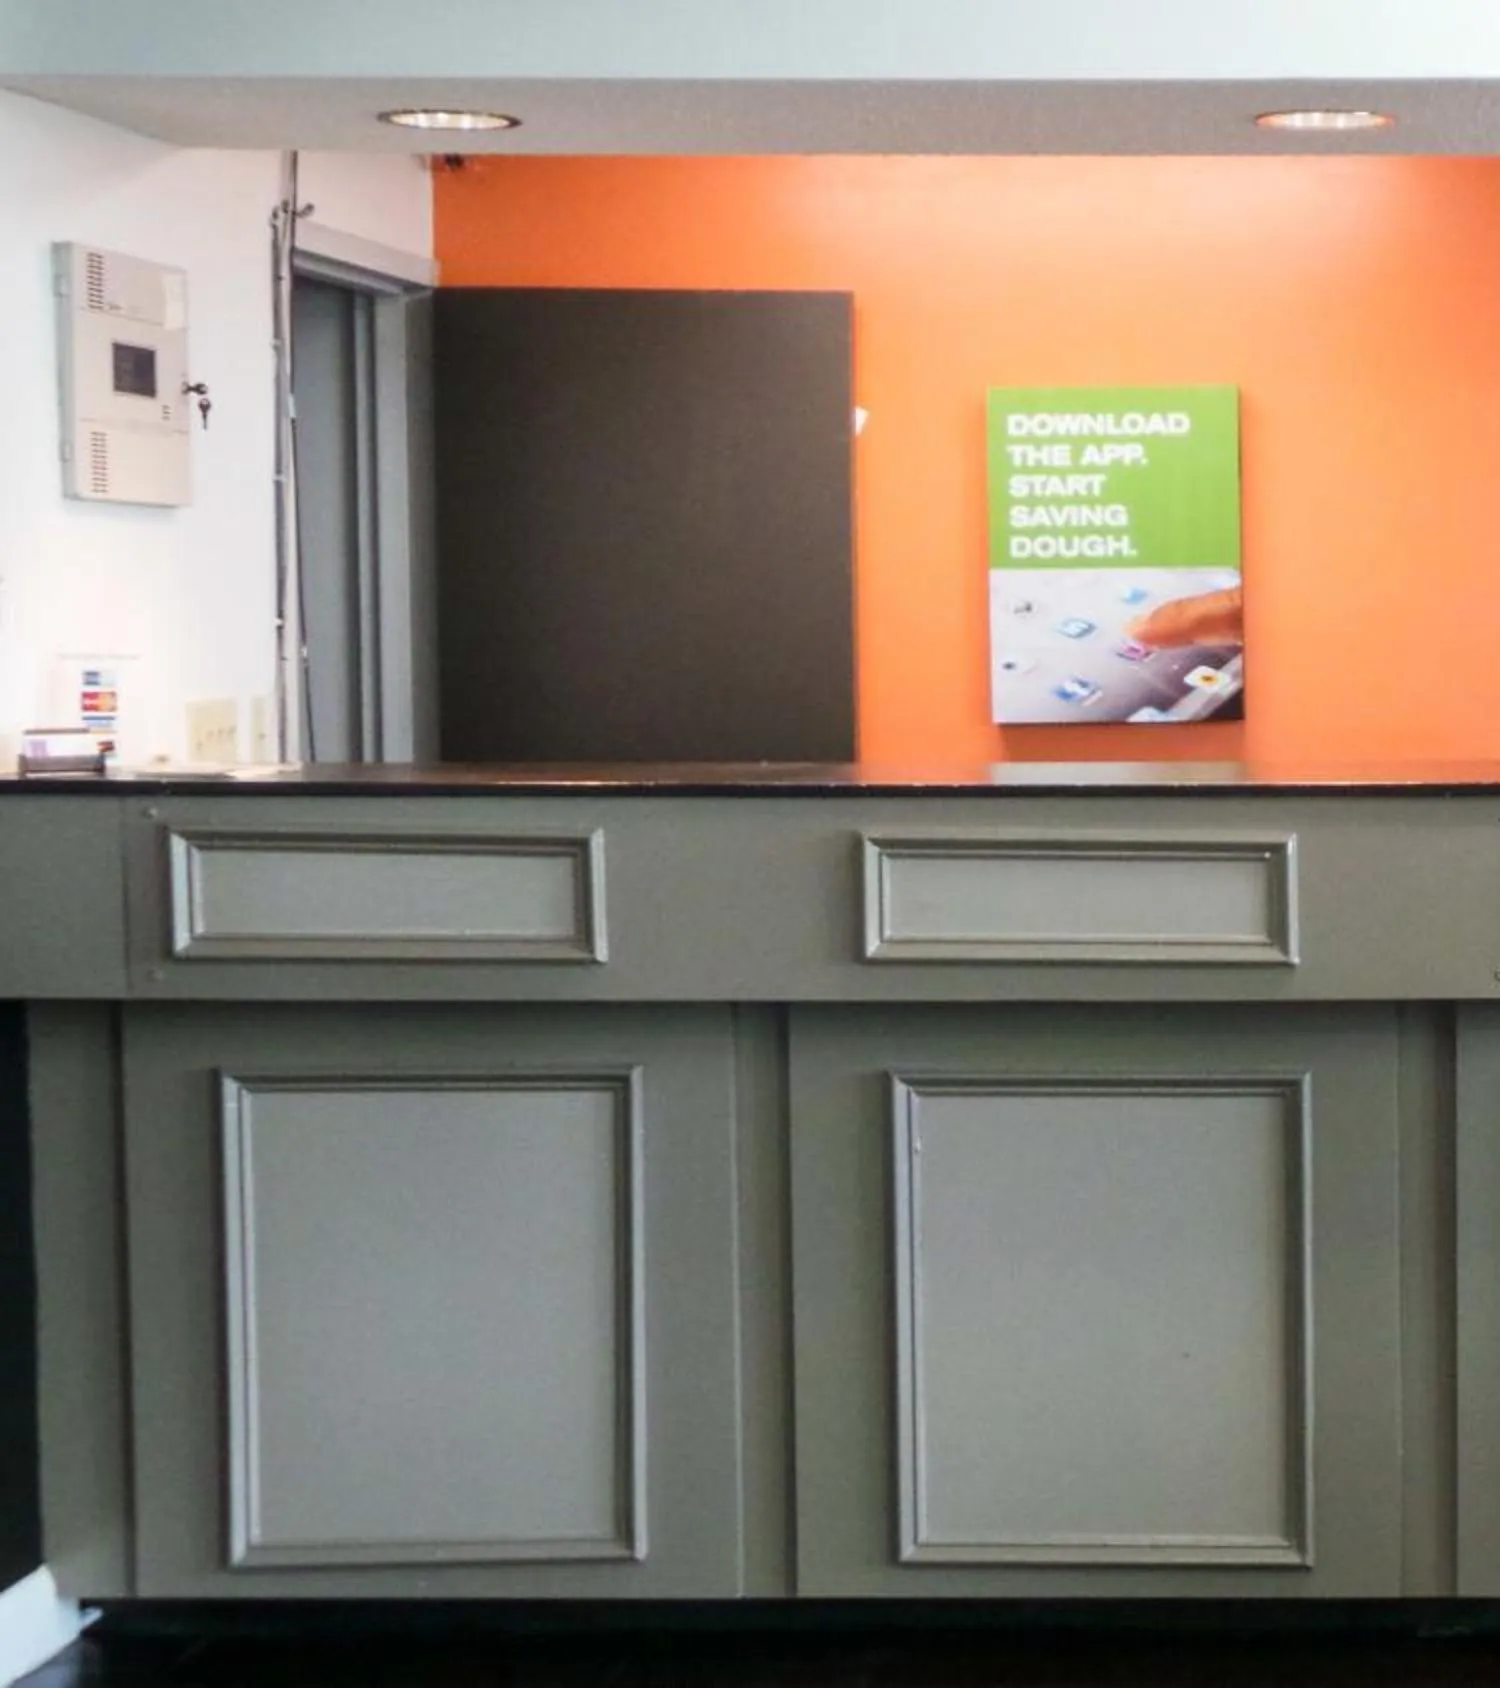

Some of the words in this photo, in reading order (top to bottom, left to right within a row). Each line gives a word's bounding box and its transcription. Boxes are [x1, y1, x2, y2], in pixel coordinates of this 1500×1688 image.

[1007, 412, 1191, 436] DOWNLOAD
[1007, 444, 1072, 467] THE
[1080, 443, 1148, 466] APP.
[1009, 474, 1106, 497] START
[1009, 505, 1128, 528] SAVING
[1009, 536, 1138, 558] DOUGH.
